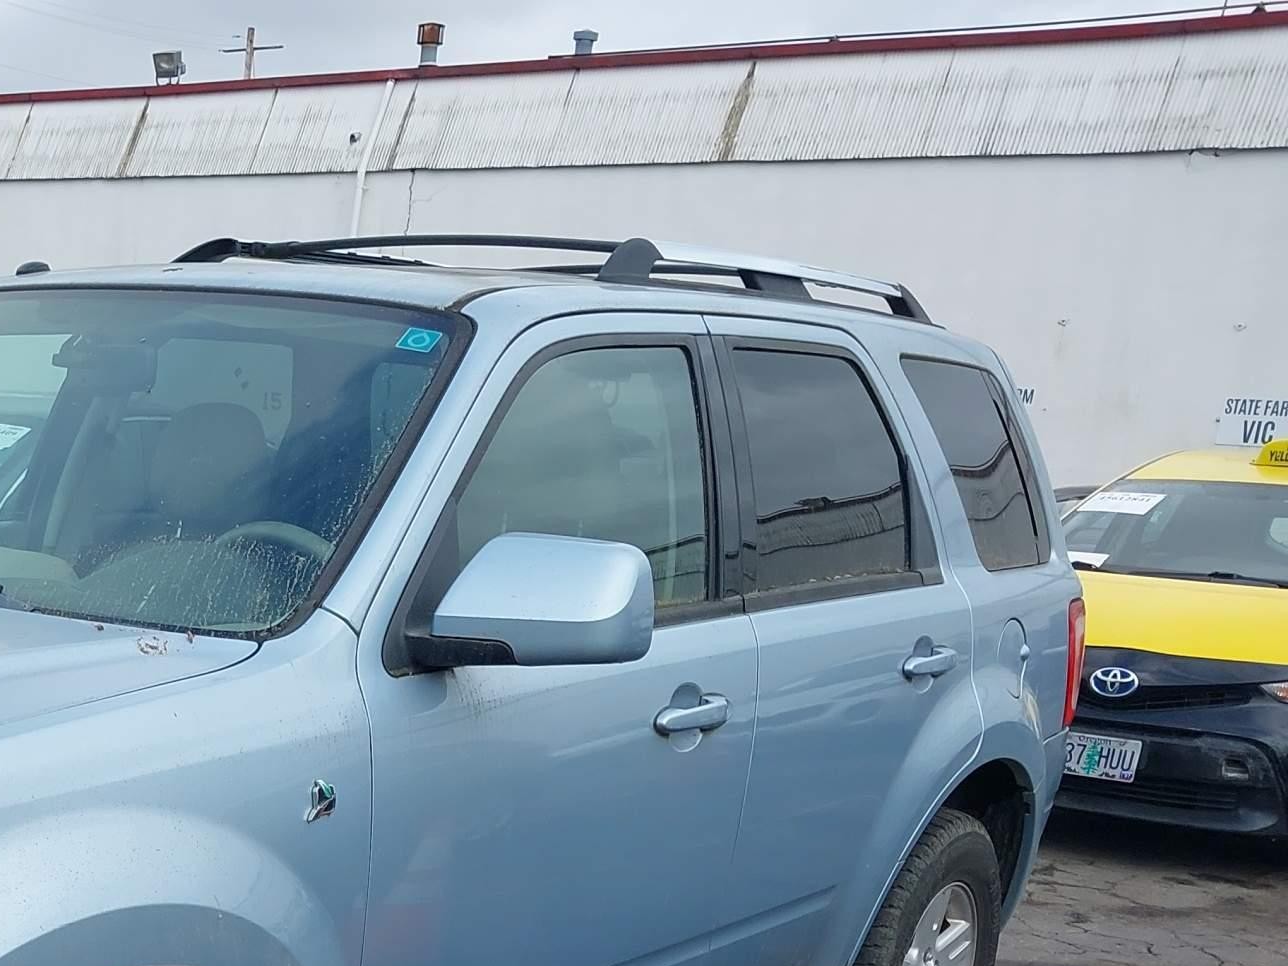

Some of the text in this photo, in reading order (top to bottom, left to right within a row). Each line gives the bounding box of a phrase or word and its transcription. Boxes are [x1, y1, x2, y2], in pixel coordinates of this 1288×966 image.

[1224, 398, 1262, 416] STATE
[1242, 419, 1276, 445] VIC
[1097, 746, 1136, 772] HUU
